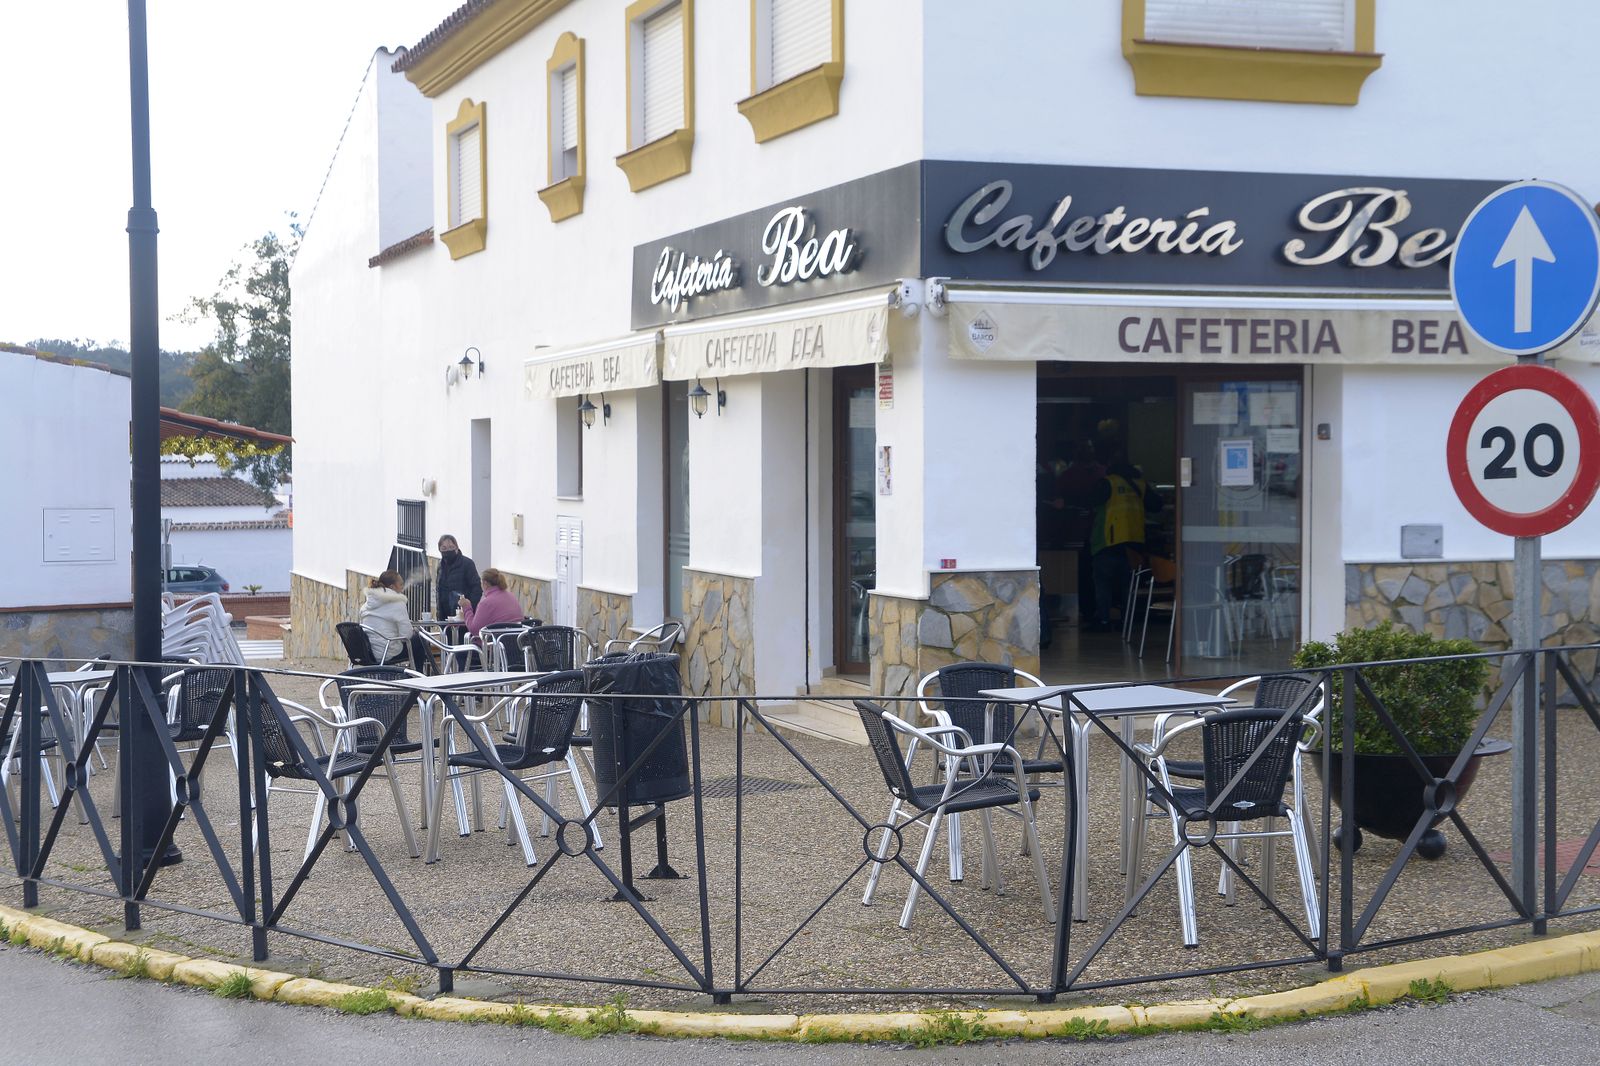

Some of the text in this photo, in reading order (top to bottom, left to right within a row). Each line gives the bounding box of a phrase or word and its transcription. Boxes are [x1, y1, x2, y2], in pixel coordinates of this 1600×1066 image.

[945, 179, 1456, 271] Cafetería Be
[651, 206, 854, 313] Cafetería Bea
[706, 324, 826, 368] CAFETERIA BEA
[1118, 316, 1469, 355] CAFETERIA BEA
[550, 355, 620, 390] CAFETERIA BEA
[1480, 422, 1564, 480] 20
